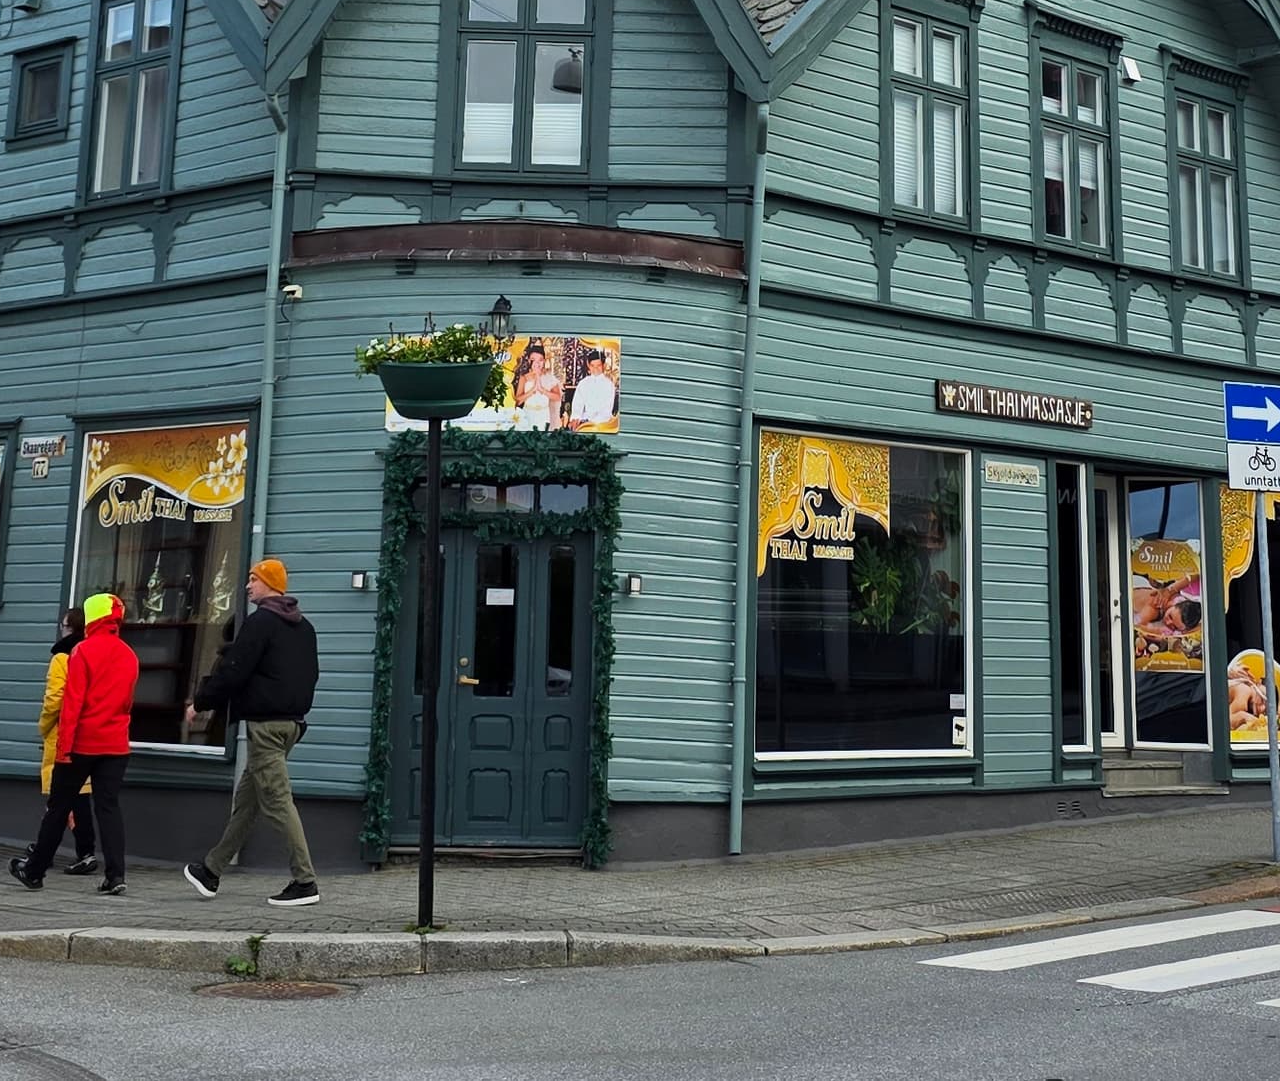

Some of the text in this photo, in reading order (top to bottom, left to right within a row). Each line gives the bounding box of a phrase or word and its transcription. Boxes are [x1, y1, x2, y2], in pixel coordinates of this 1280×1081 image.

[957, 385, 1086, 426] SMIL THAI MASSASJE
[99, 479, 155, 528] Smil
[155, 497, 188, 521] THAI
[792, 490, 856, 542] Smil
[770, 538, 808, 561] THAI
[1139, 546, 1173, 564] Smil
